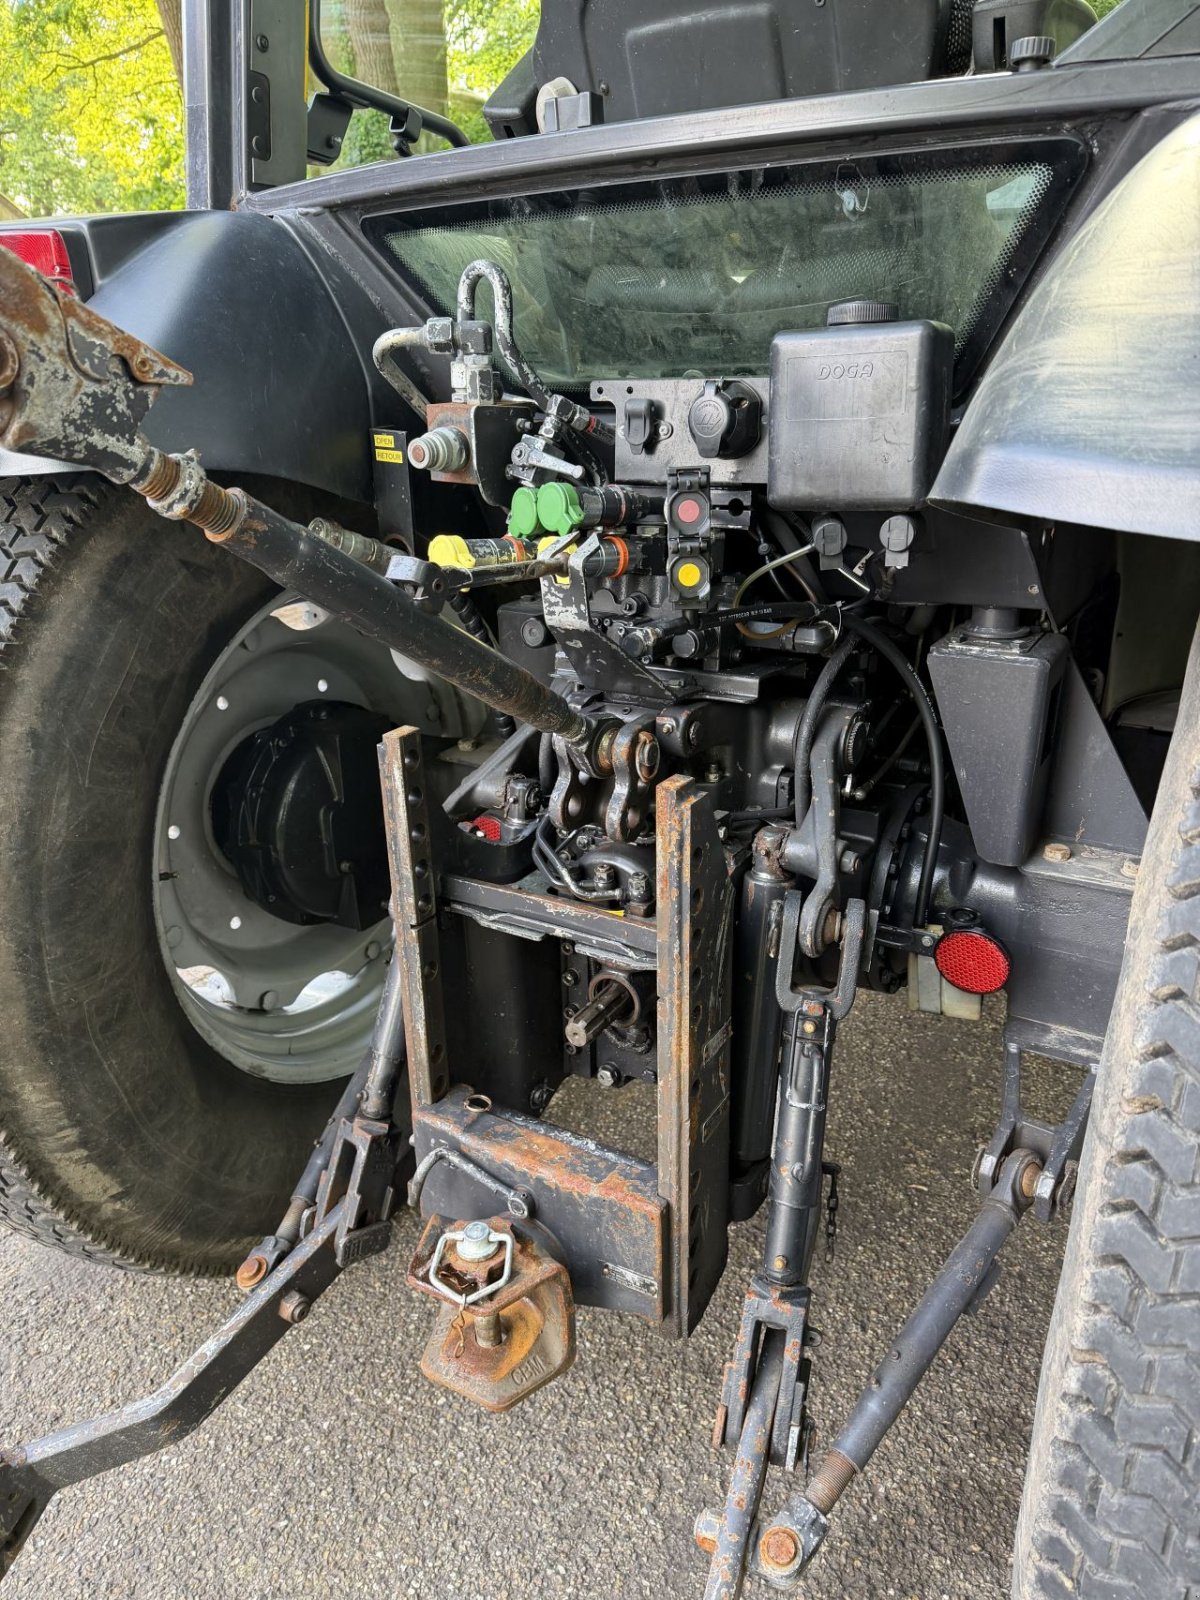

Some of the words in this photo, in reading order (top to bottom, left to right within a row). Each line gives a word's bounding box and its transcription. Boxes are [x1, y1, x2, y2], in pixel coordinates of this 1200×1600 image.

[816, 361, 874, 381] DOGA
[376, 437, 393, 446] OPEN
[377, 452, 402, 462] RETOUR
[511, 1355, 546, 1386] CBM
